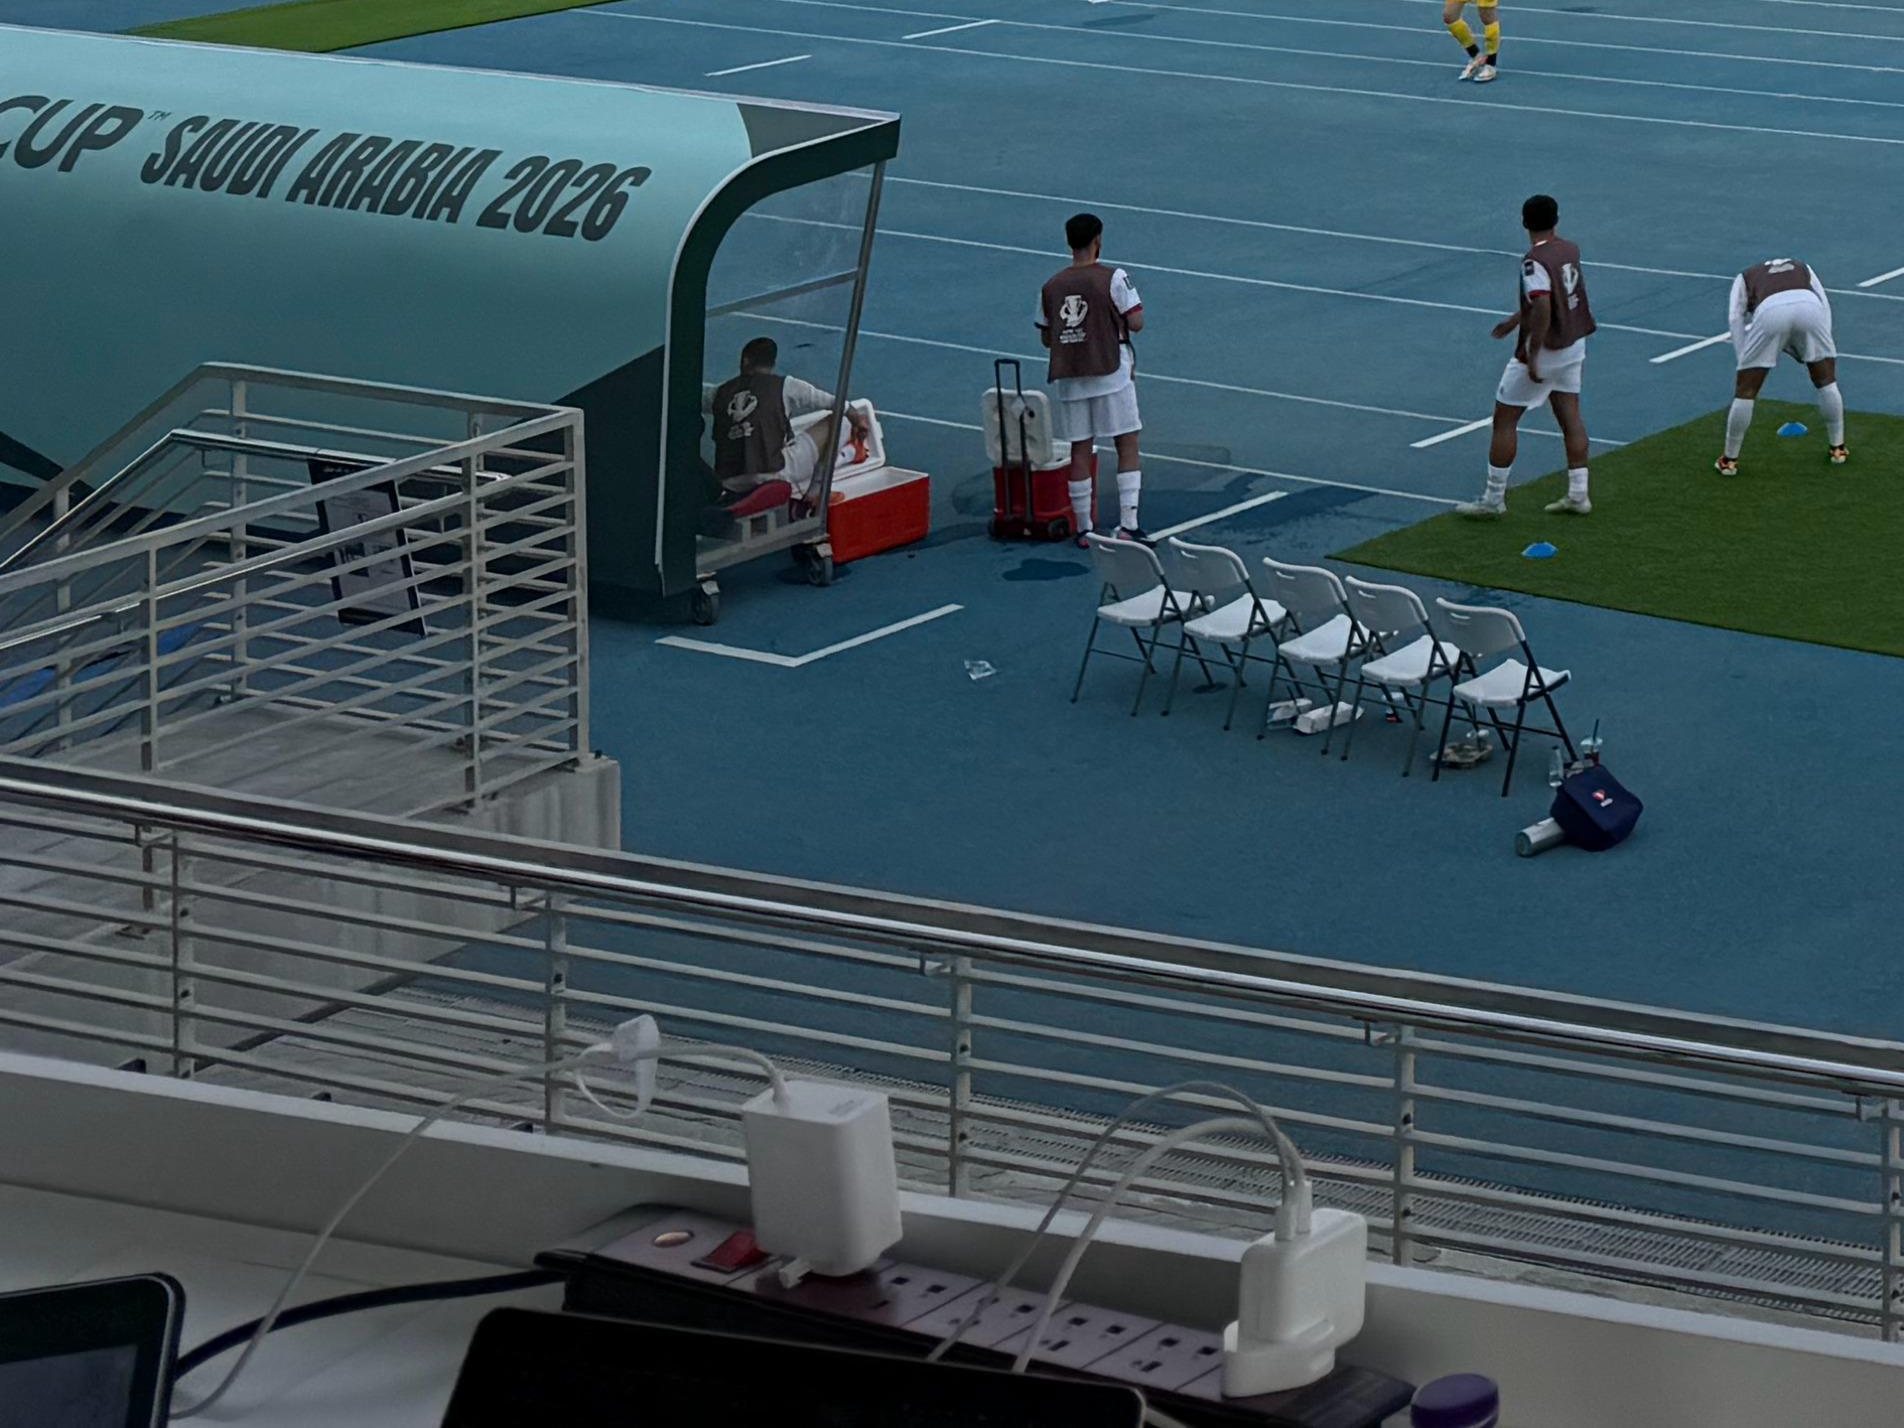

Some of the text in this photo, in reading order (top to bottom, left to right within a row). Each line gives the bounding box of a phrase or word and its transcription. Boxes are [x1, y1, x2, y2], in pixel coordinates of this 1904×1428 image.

[140, 115, 300, 199] SAUDI
[286, 130, 502, 224] ARABIA
[476, 156, 652, 242] 2026
